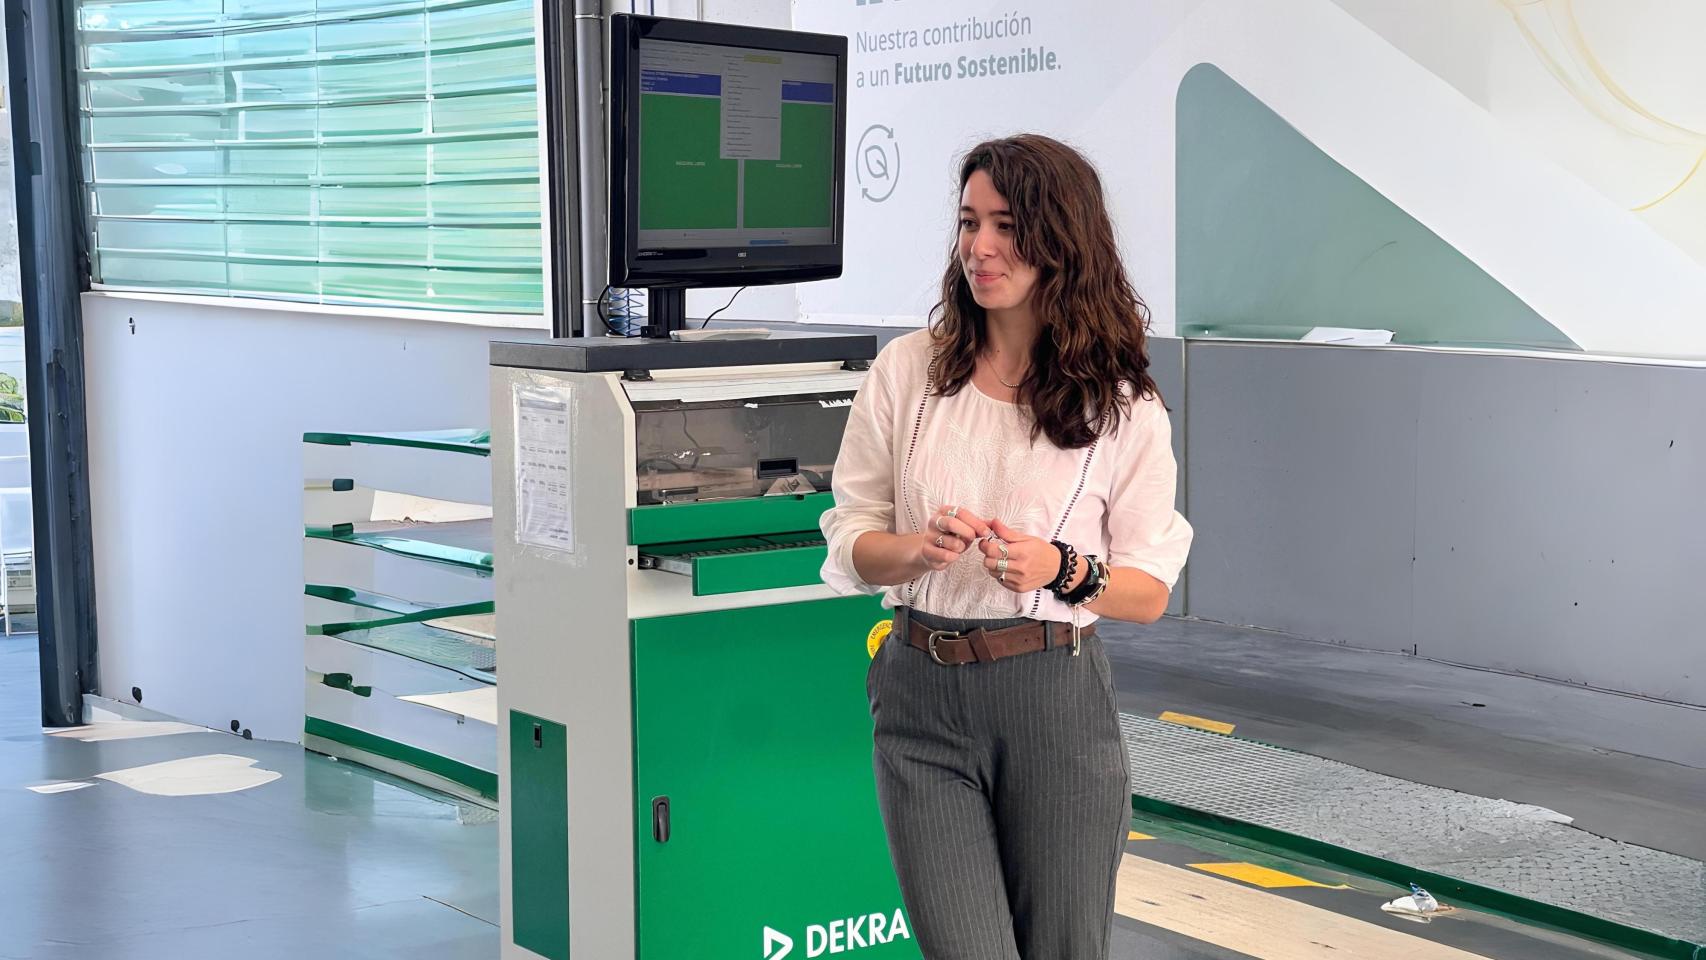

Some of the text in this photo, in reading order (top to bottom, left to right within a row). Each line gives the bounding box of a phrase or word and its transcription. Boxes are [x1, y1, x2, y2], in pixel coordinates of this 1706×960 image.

[856, 11, 1032, 54] Nuestra contribución
[856, 46, 1062, 88] a un Futuro Sostenible.
[806, 908, 911, 958] DEKRA
